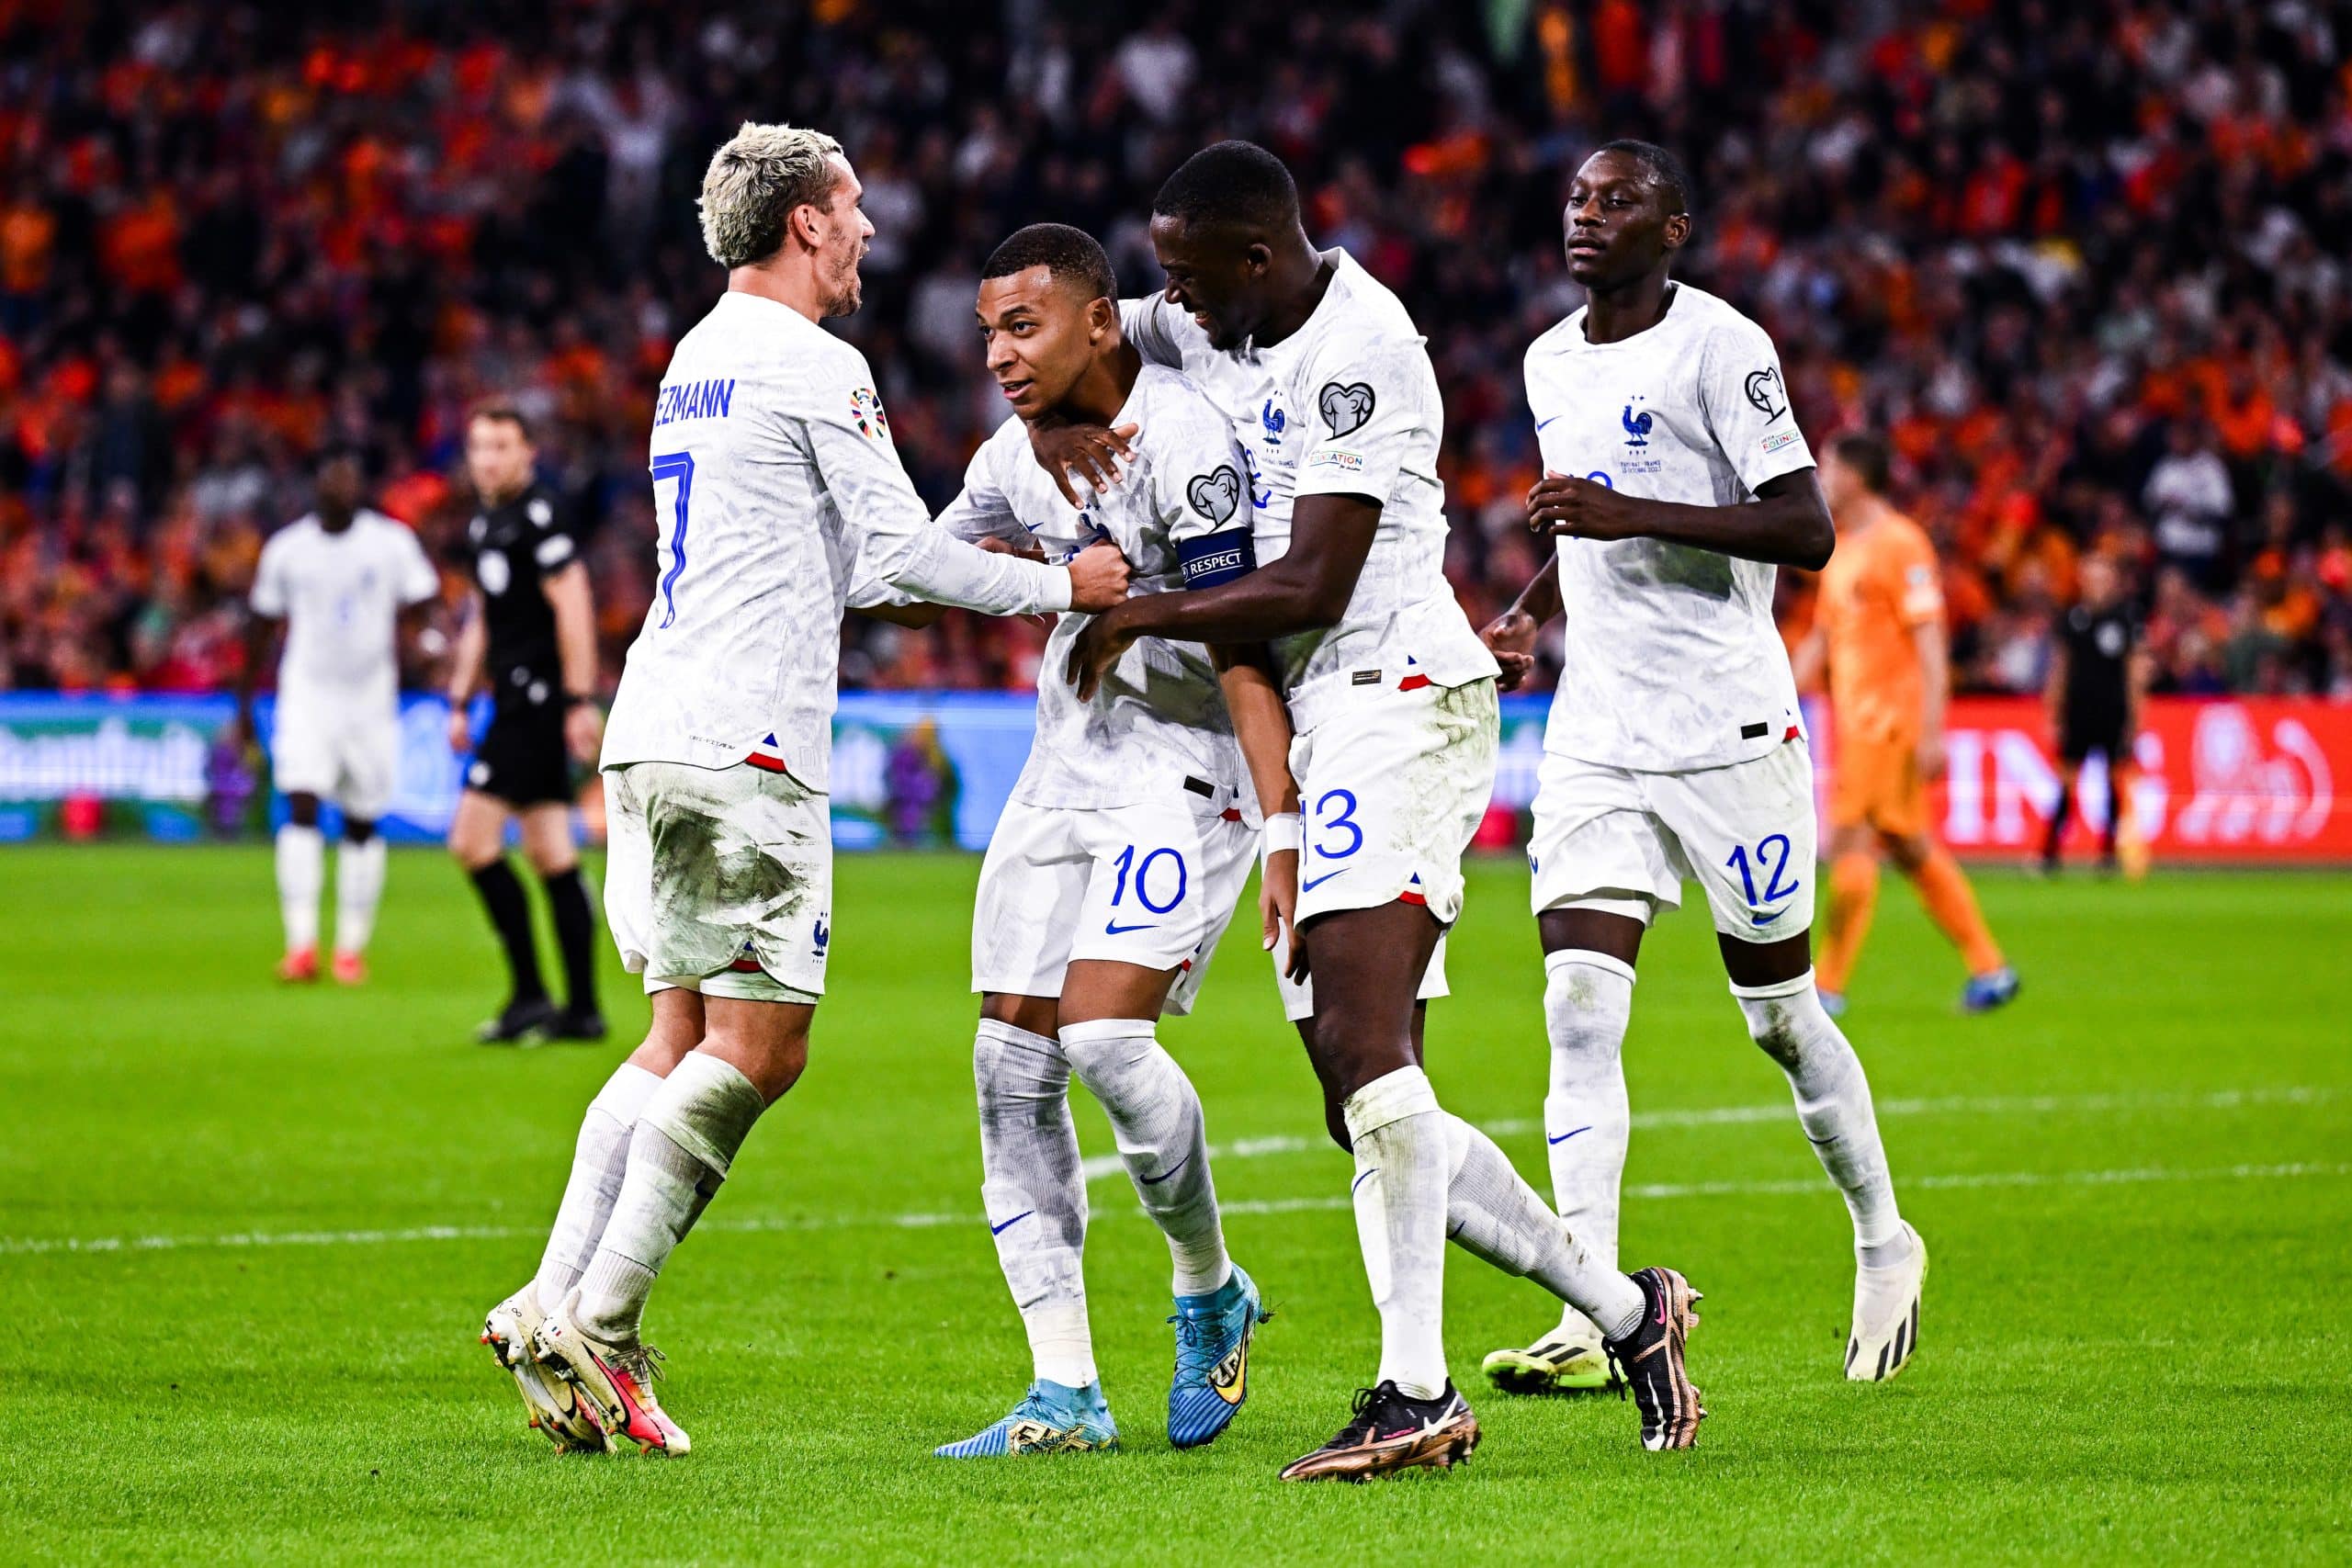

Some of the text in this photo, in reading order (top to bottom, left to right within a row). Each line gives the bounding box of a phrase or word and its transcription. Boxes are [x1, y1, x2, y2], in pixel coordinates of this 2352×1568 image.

[652, 451, 695, 629] 7
[1190, 552, 1241, 575] RESPECT
[1111, 844, 1187, 914] 10
[1725, 833, 1800, 907] 12
